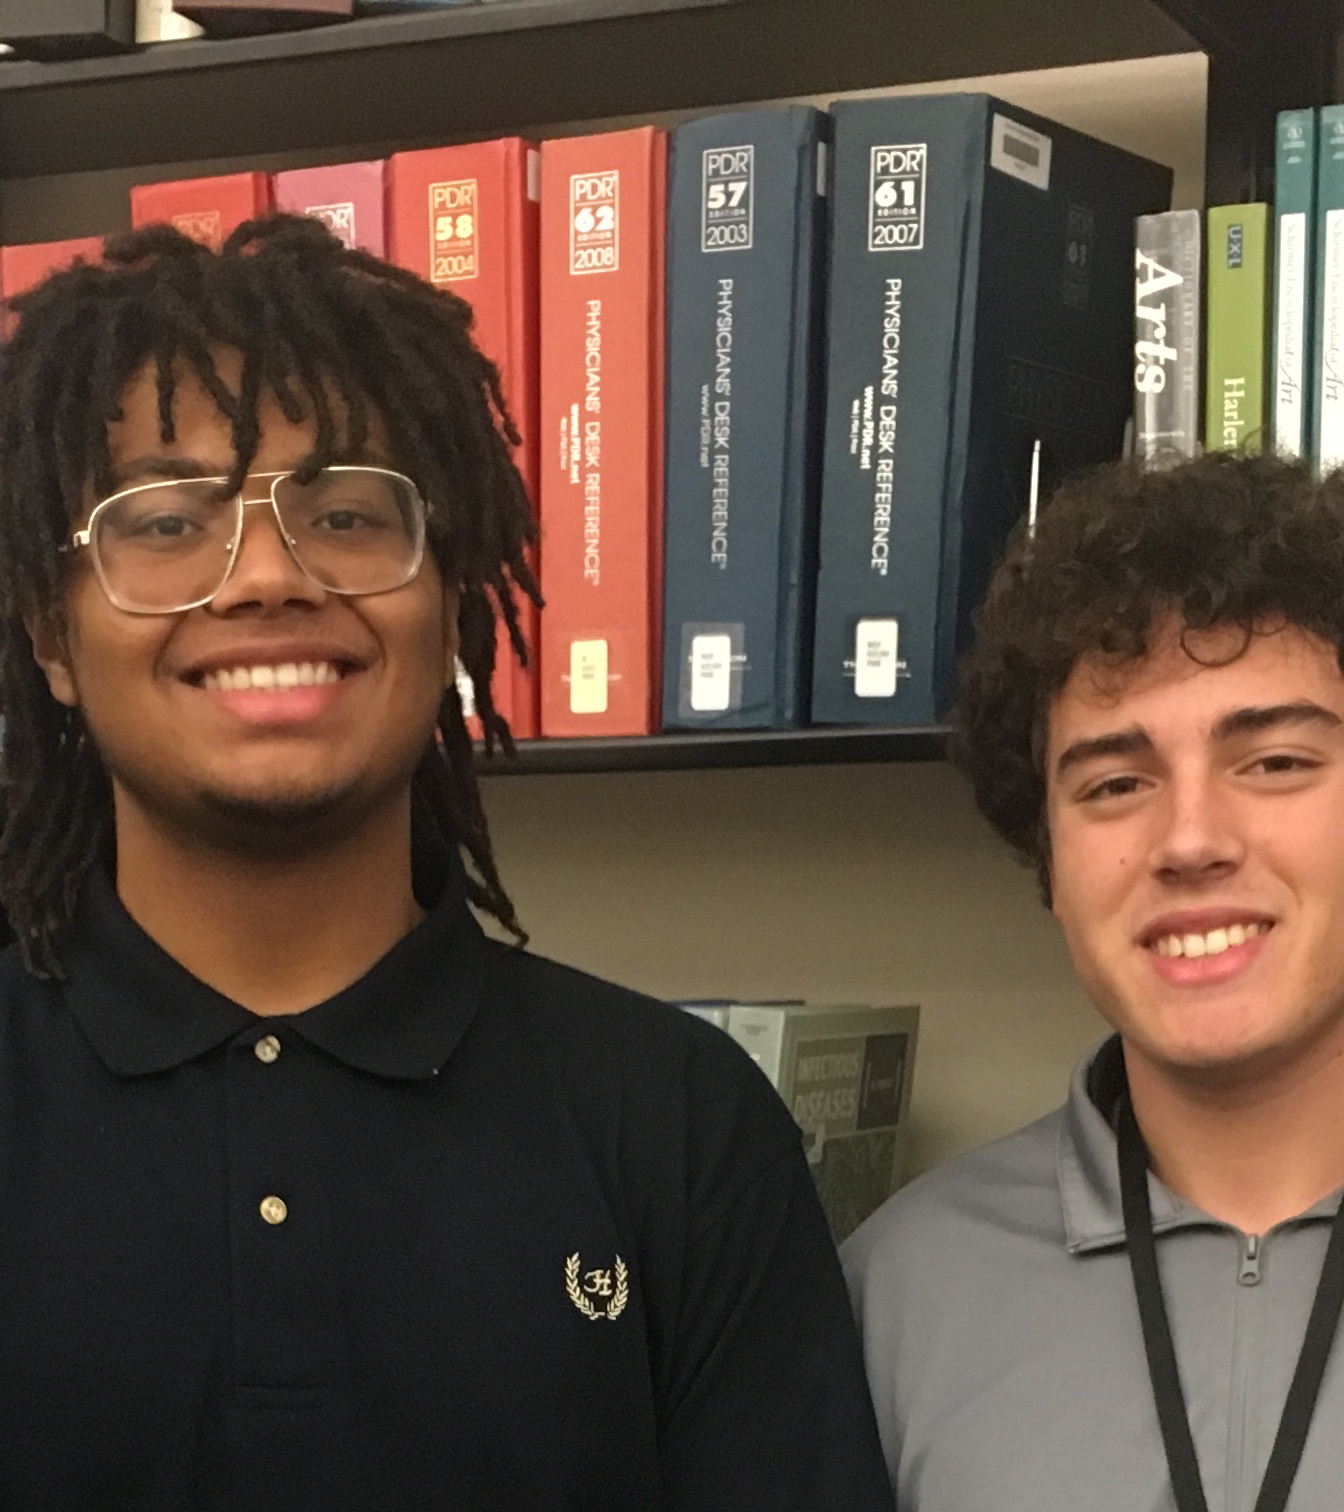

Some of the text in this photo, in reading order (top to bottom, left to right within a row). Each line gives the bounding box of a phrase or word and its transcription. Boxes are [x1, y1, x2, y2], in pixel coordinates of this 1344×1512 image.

[707, 151, 749, 176] PDR
[875, 149, 924, 173] PDR
[434, 184, 473, 208] PDR
[575, 178, 615, 200] PDR
[707, 182, 748, 208] 57
[875, 182, 915, 207] 61
[435, 215, 474, 240] 58
[575, 206, 615, 233] 62
[707, 225, 748, 246] 2003
[874, 224, 918, 245] 2007
[435, 253, 474, 276] 2004
[574, 248, 614, 269] 2008
[1134, 247, 1184, 394] Arts
[1280, 361, 1301, 404] Art
[714, 401, 731, 450] DESK
[878, 405, 898, 454] DESK
[584, 421, 601, 468] DESK
